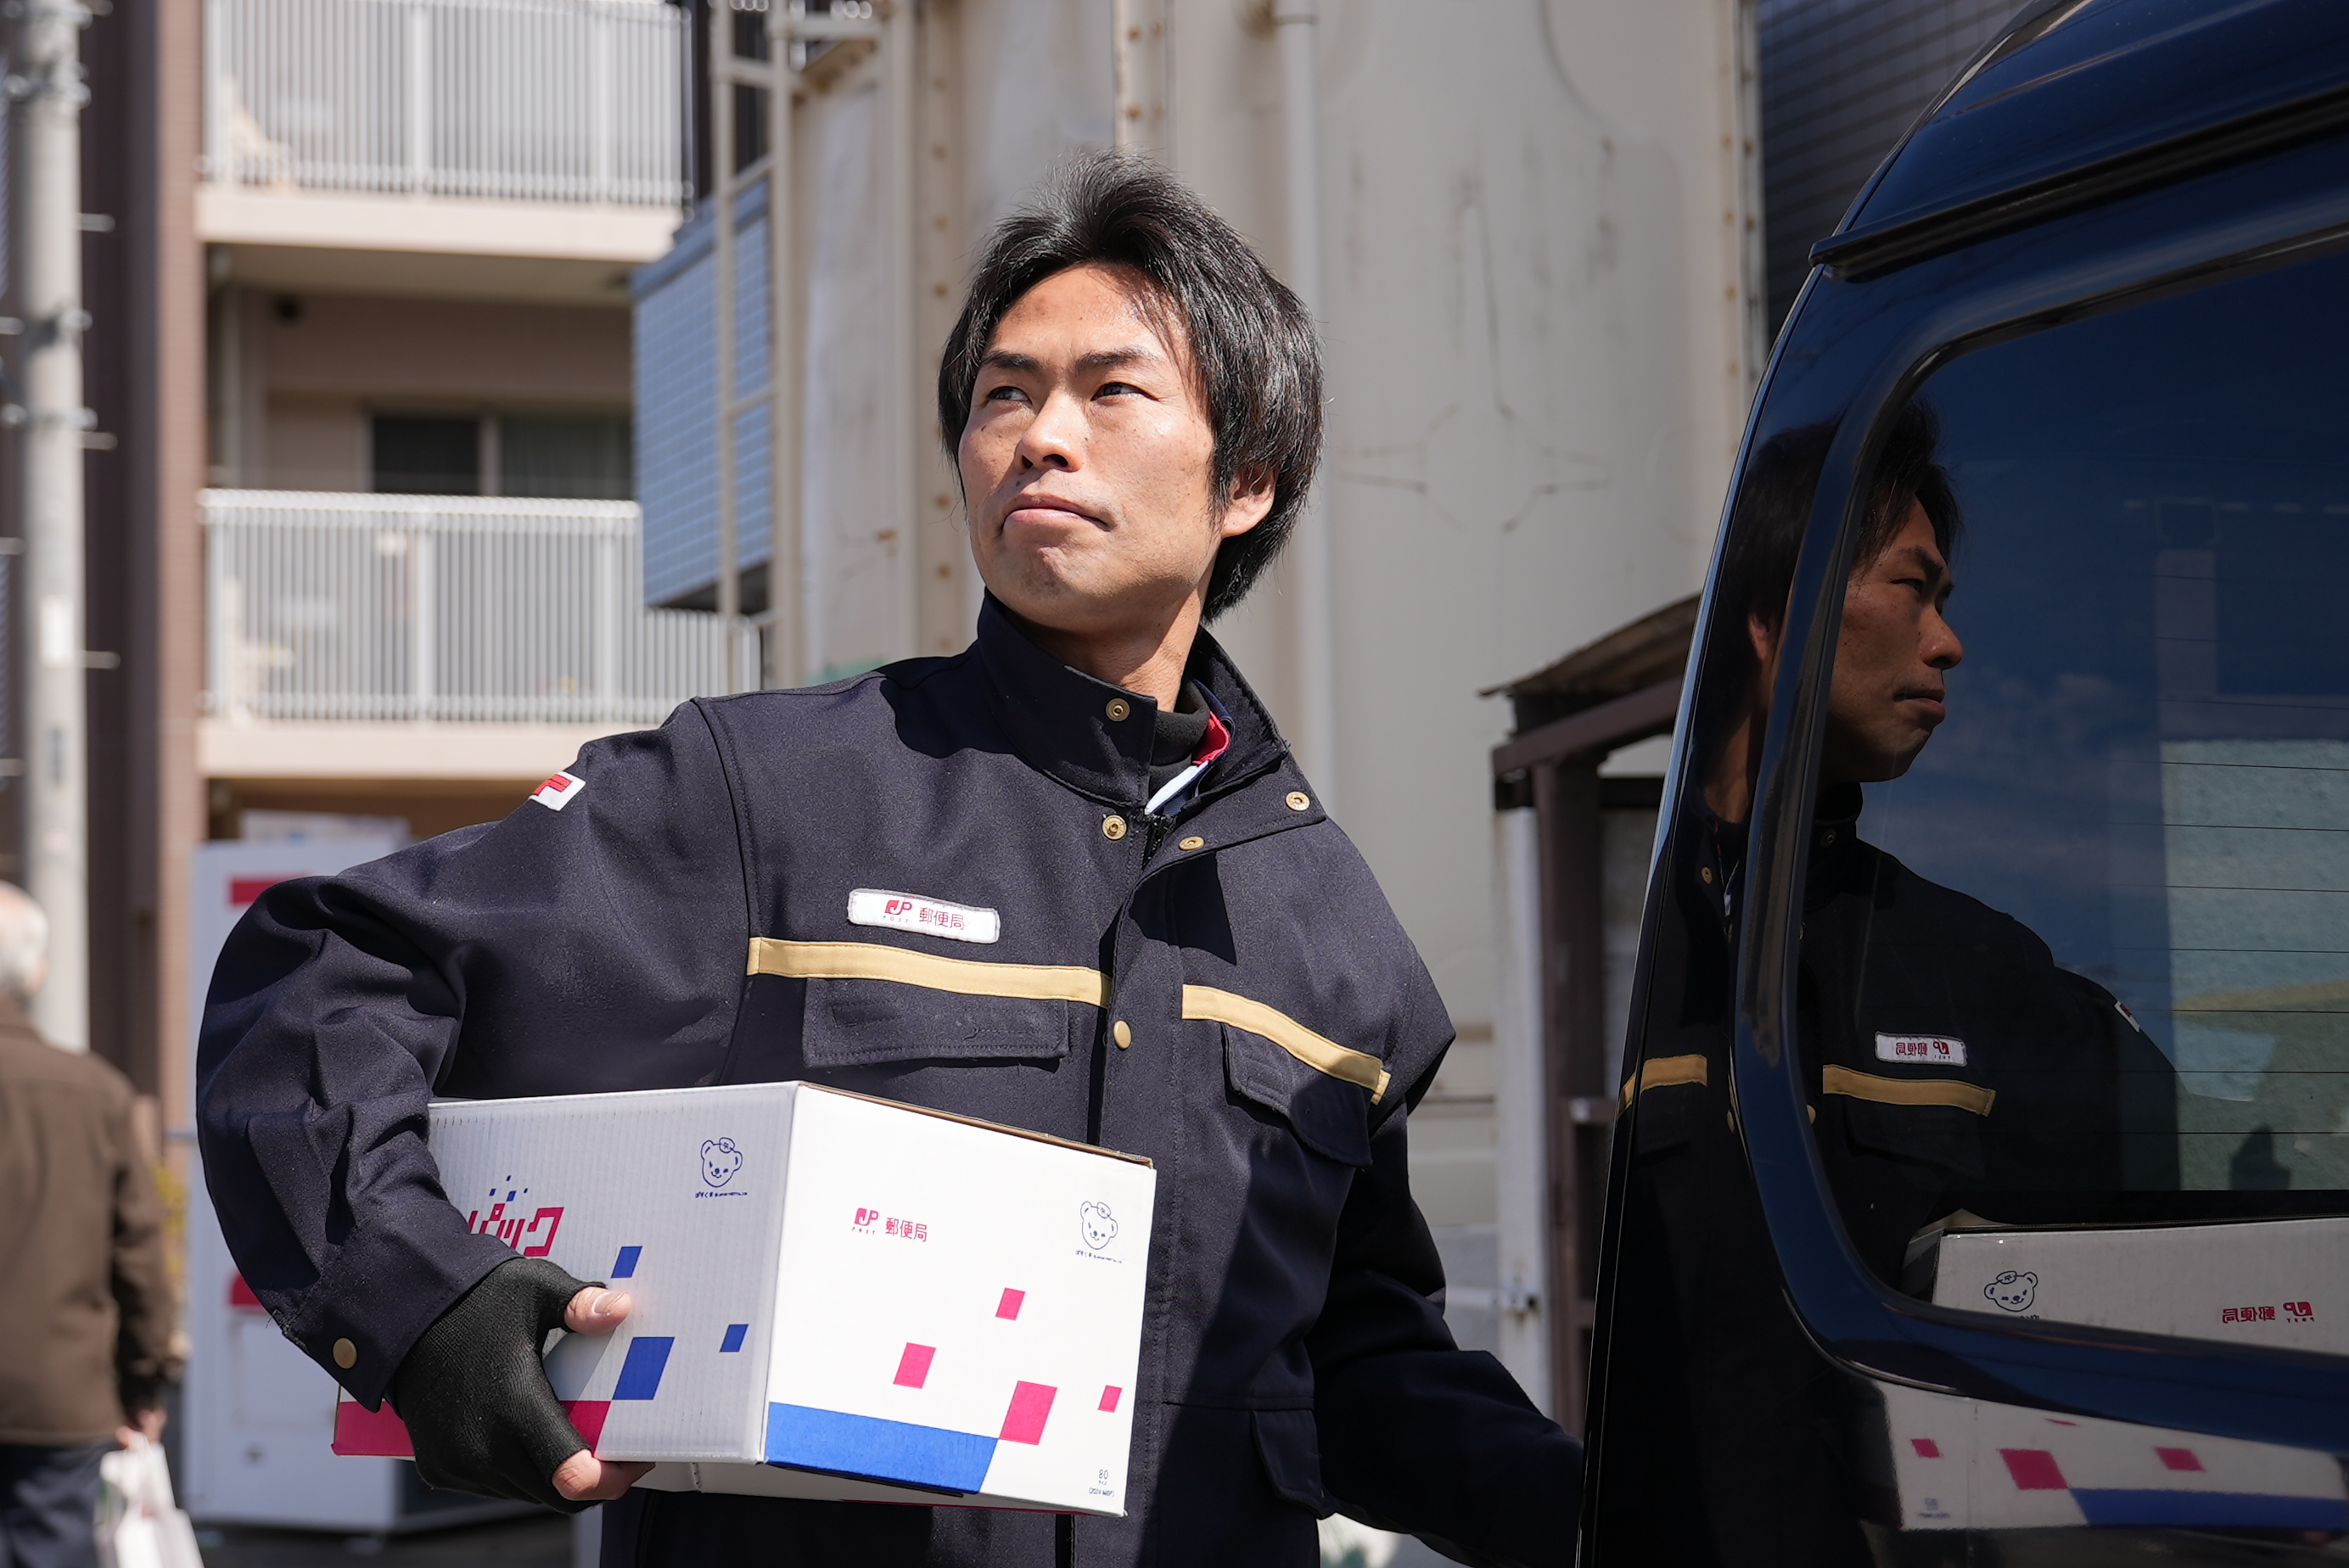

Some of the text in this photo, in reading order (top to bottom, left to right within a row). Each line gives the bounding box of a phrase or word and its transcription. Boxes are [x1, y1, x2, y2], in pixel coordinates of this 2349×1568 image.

[884, 899, 912, 916] JP
[919, 907, 965, 930] 郵便局
[854, 1207, 879, 1226] JP
[885, 1217, 927, 1242] 郵便局
[1098, 1469, 1109, 1480] 80
